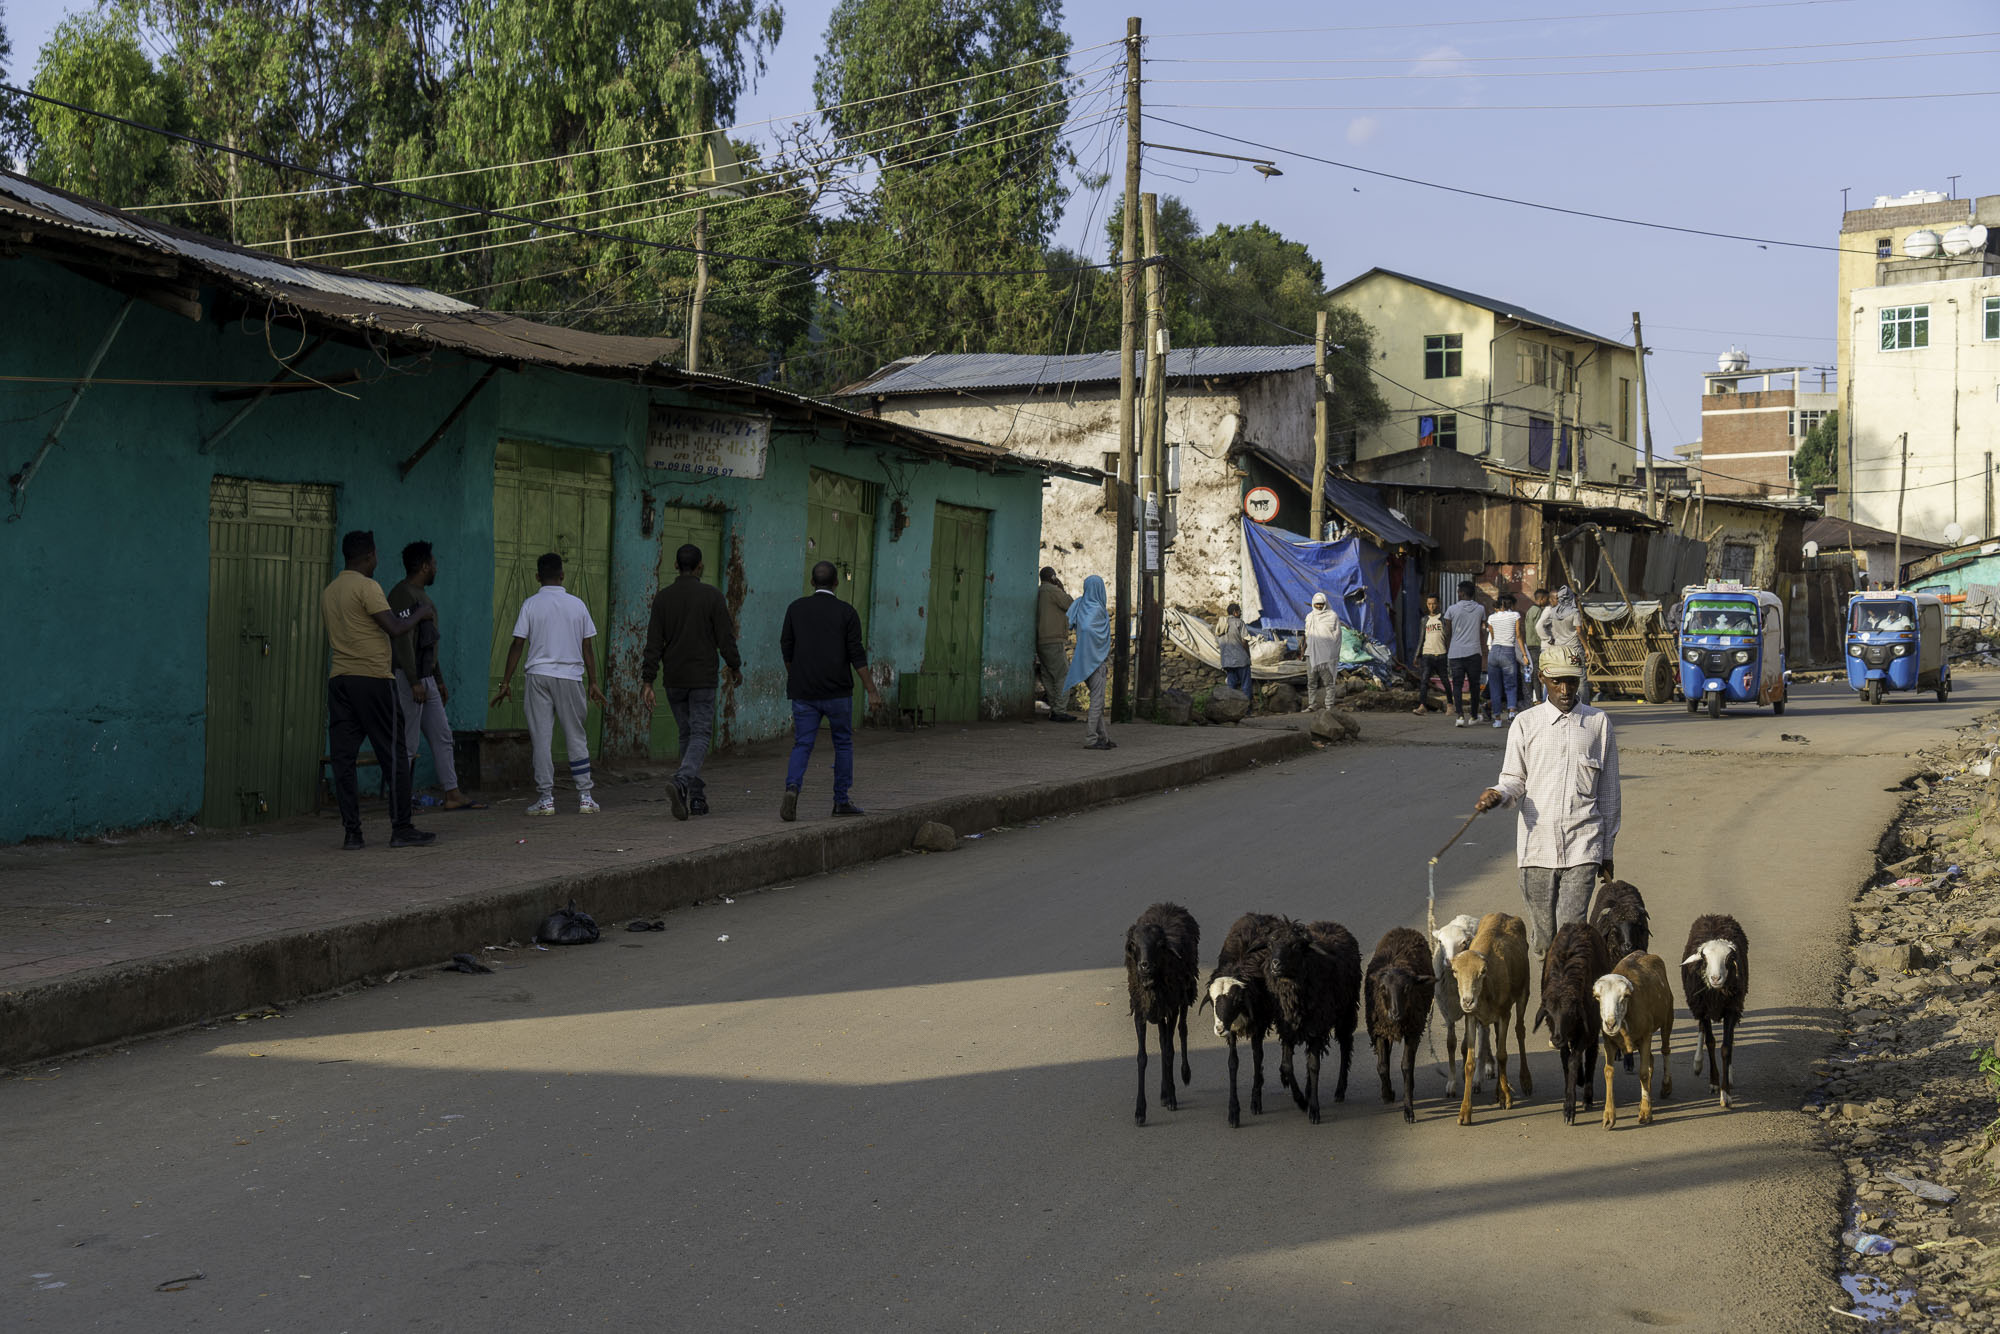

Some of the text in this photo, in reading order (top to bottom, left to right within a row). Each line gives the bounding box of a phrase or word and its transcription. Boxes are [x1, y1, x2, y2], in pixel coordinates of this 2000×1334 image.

[694, 463, 704, 473] 19
[707, 465, 719, 475] 98
[721, 467, 734, 477] 97
